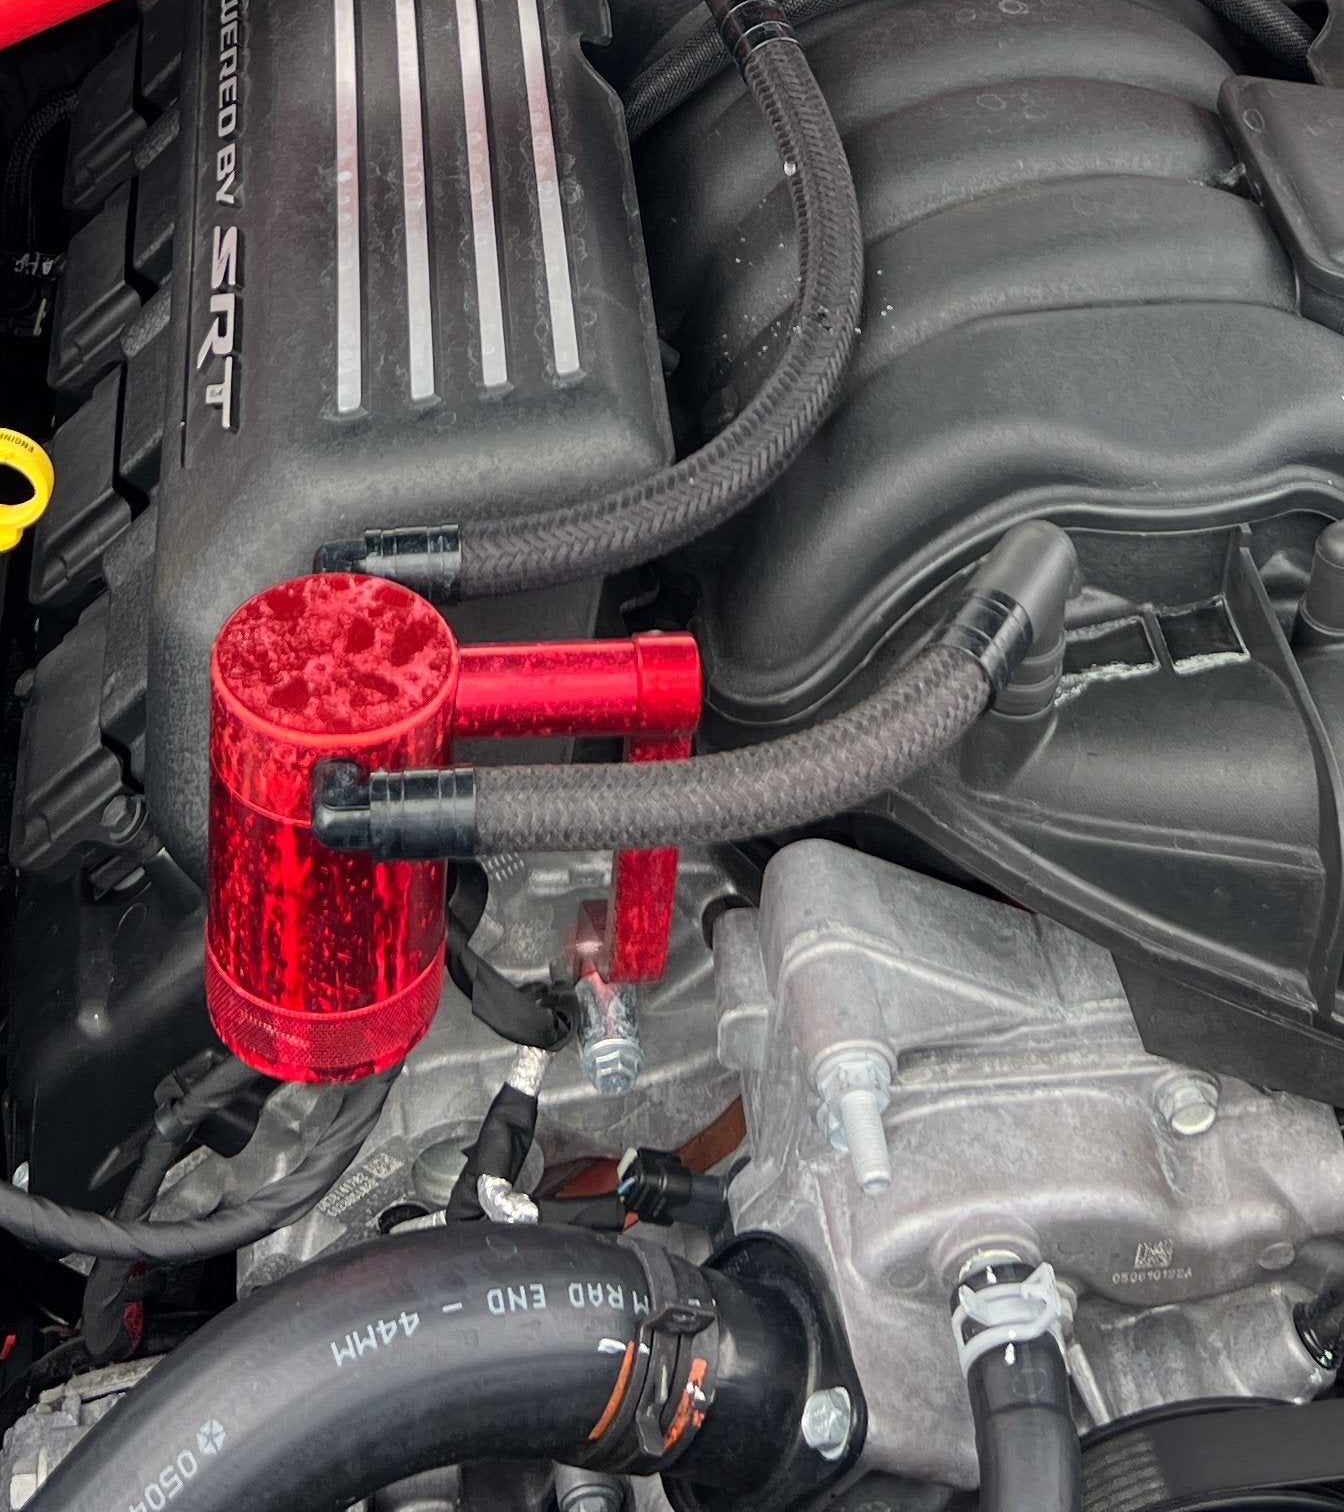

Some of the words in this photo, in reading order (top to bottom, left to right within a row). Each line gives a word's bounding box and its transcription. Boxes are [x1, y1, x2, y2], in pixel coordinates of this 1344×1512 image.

[216, 142, 237, 206] BY
[196, 225, 240, 430] SRT
[486, 1282, 547, 1316] END
[568, 1281, 626, 1311] RAD
[330, 1310, 421, 1368] 44MM
